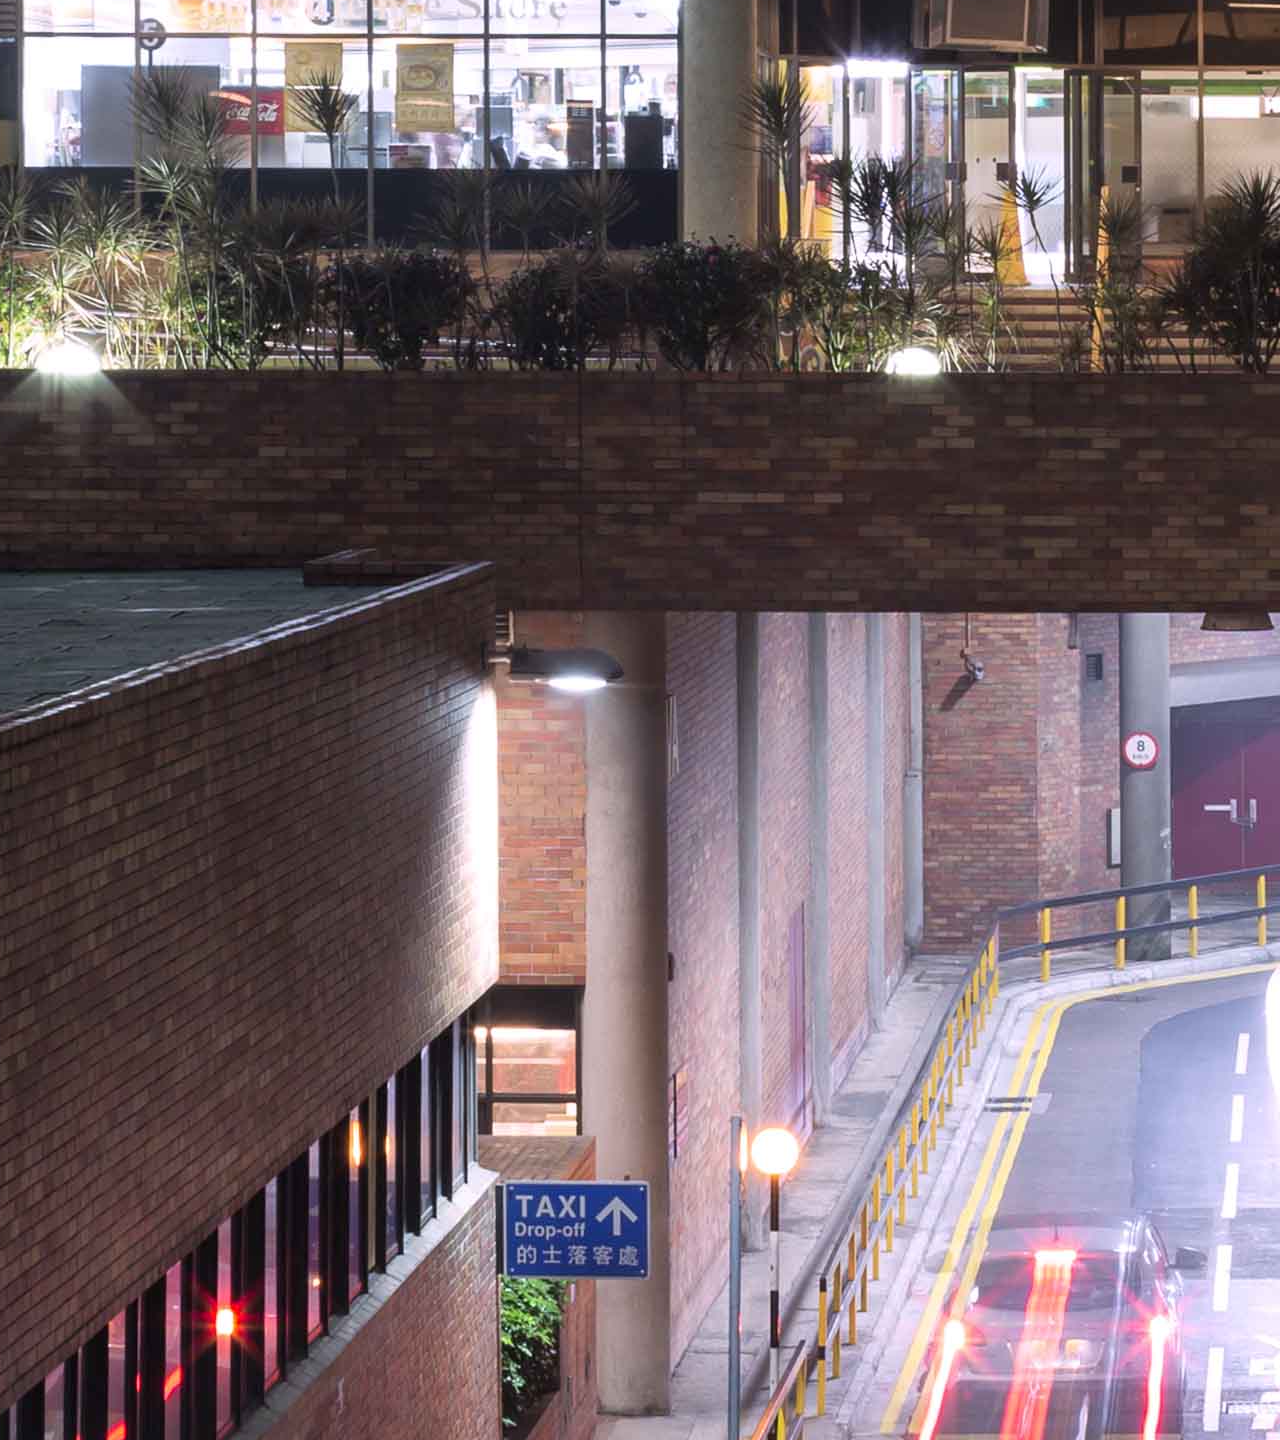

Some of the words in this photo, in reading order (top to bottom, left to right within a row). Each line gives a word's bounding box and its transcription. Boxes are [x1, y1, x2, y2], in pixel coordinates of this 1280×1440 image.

[225, 102, 280, 122] CocaCola
[1136, 739, 1145, 752] 8
[515, 1195, 587, 1218] TAXI
[514, 1221, 586, 1240] Drop-off
[517, 1244, 639, 1266] 的士落客處
